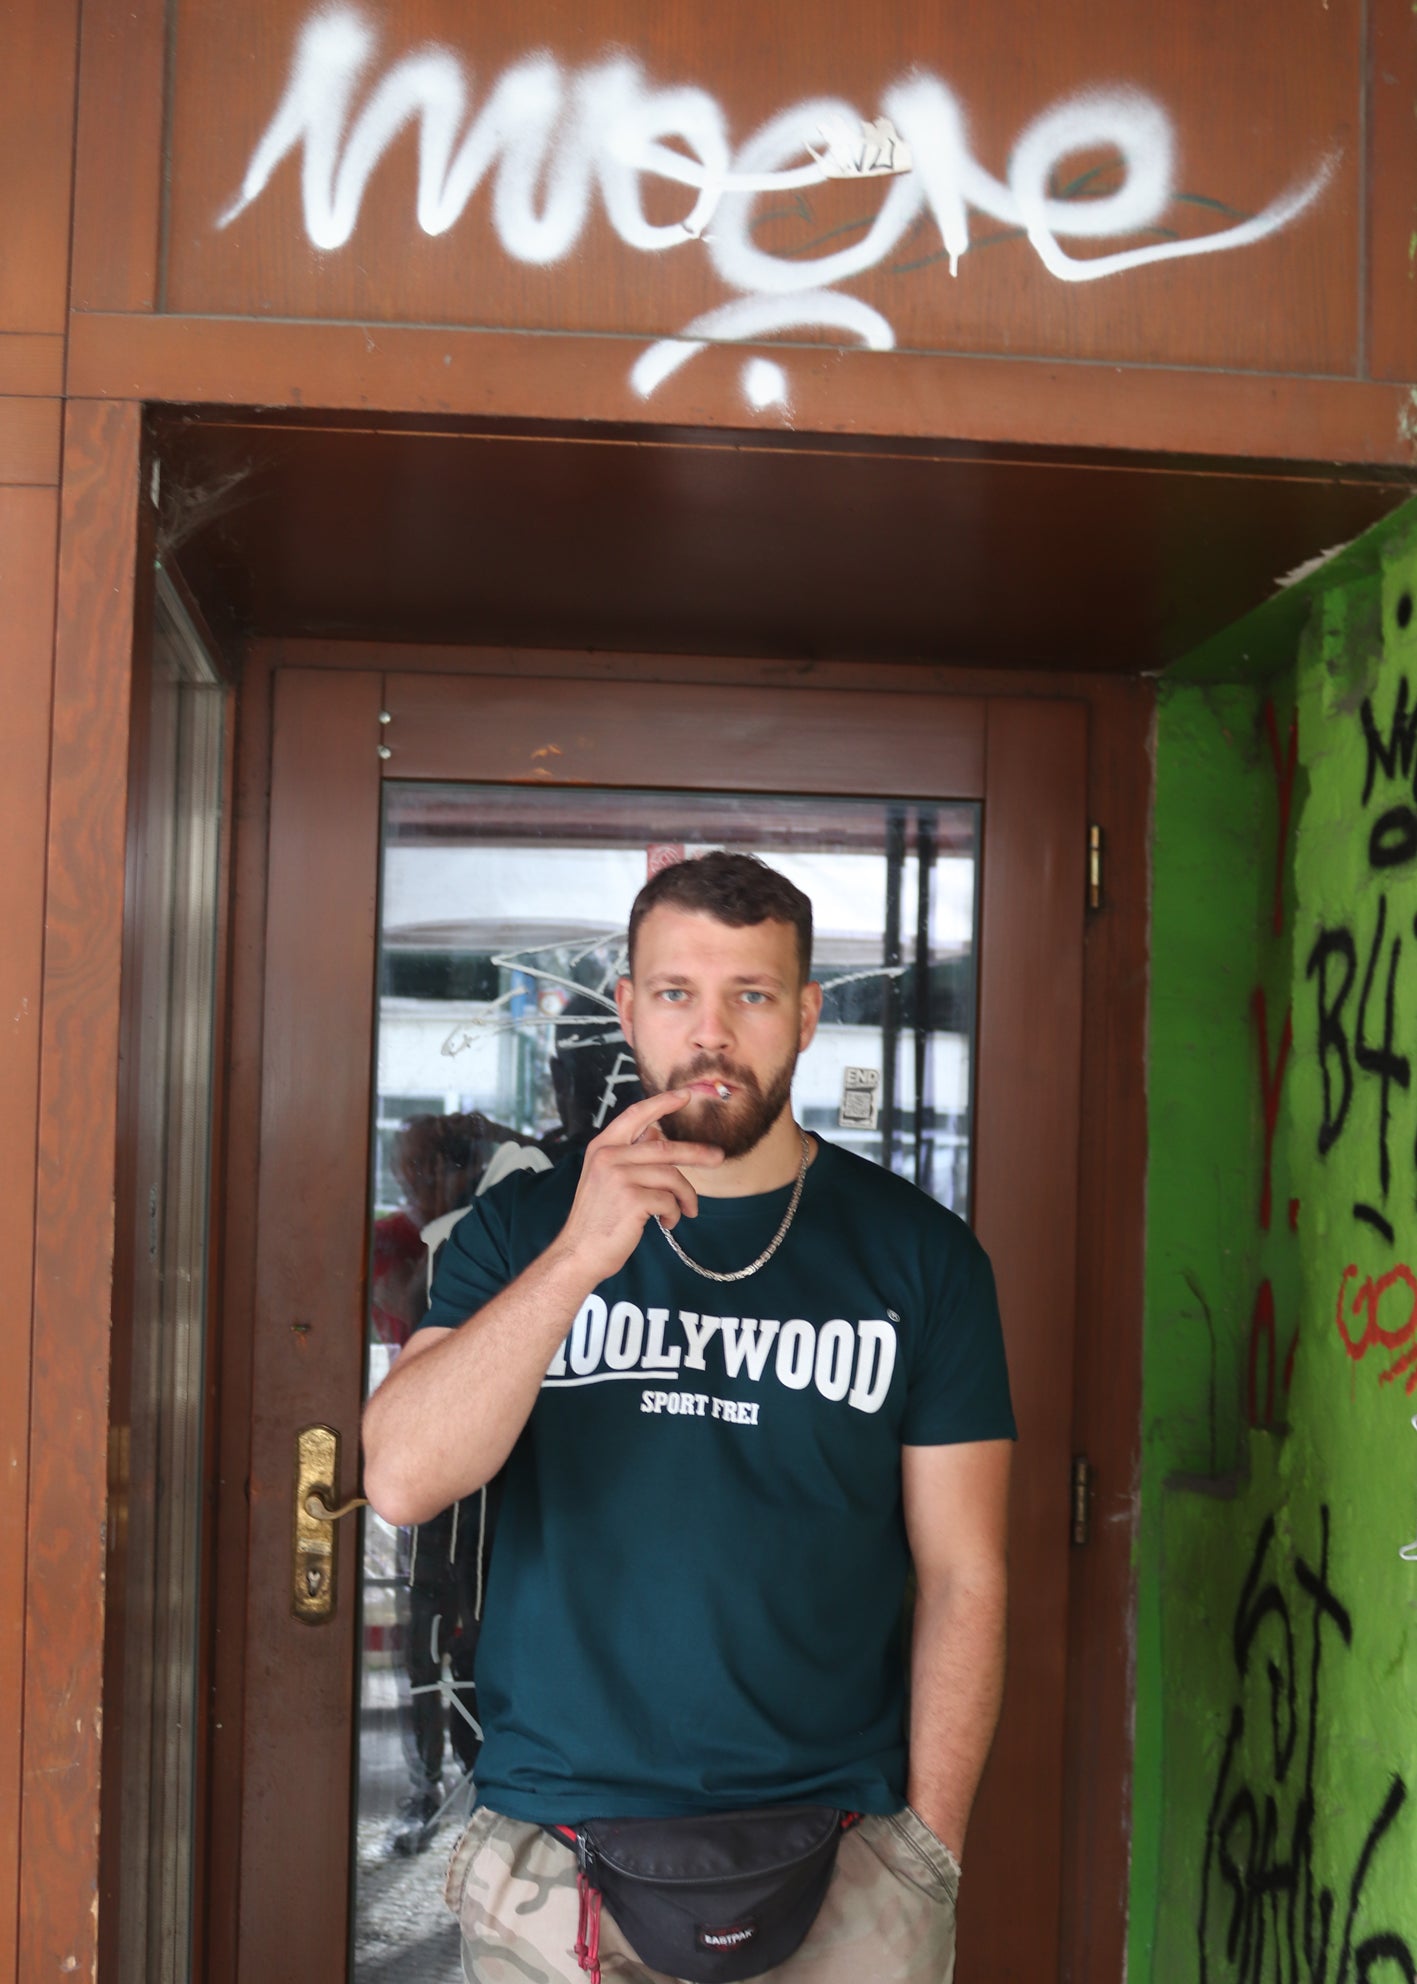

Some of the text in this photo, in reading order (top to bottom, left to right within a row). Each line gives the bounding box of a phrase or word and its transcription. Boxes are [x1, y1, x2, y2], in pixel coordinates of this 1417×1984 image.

[545, 1293, 898, 1414] OOLYWOOD
[640, 1390, 760, 1426] SPORT FREI
